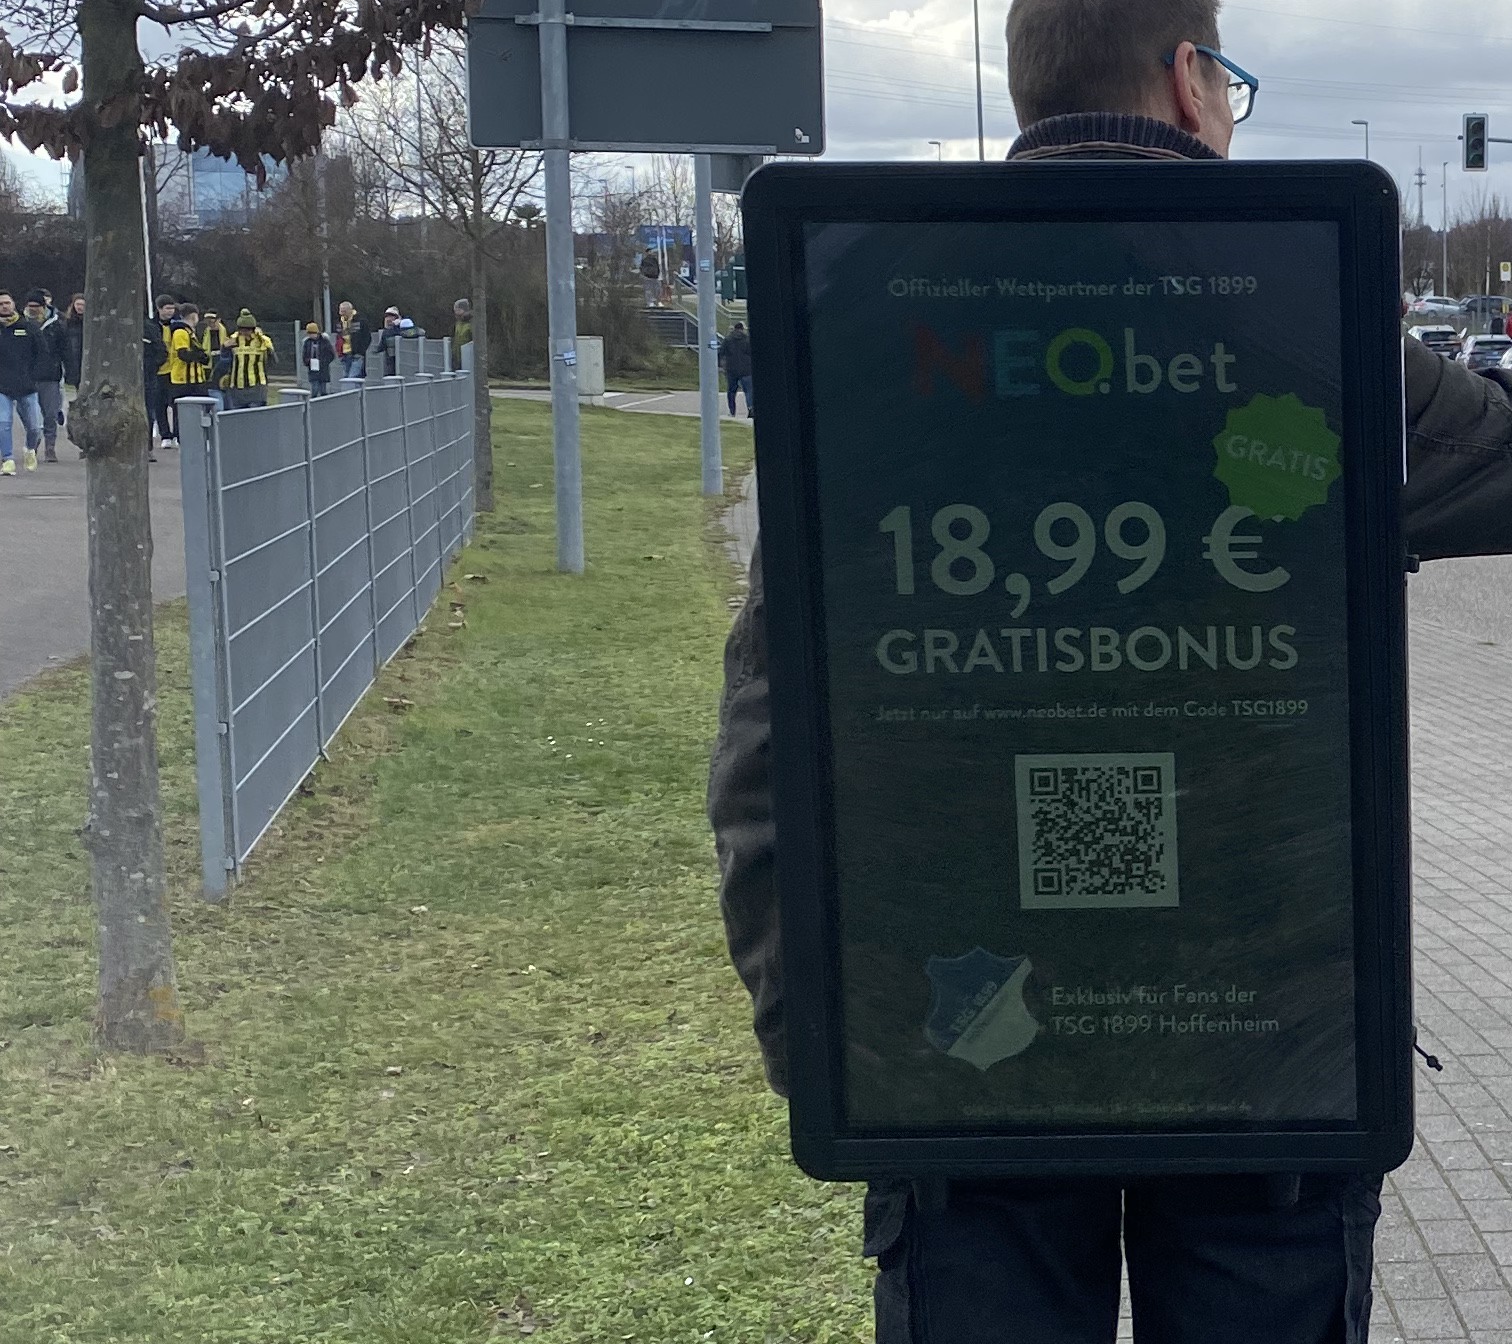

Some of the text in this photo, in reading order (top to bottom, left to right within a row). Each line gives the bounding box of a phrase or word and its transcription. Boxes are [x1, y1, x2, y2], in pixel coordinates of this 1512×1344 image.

[888, 275, 1258, 303] Offizieller Wettpartner der TSG 1899
[1225, 434, 1331, 482] GRATIS
[877, 501, 1293, 619] 18,99 €
[874, 624, 1300, 675] GRATISBONUS
[875, 699, 1310, 722] Jetzt nur auf www.neobet.de mit dem Code TSG1899
[1051, 983, 1258, 1006] Exklusiv für Fans der
[1051, 1013, 1281, 1035] TSG 1899 Hoffenheim
